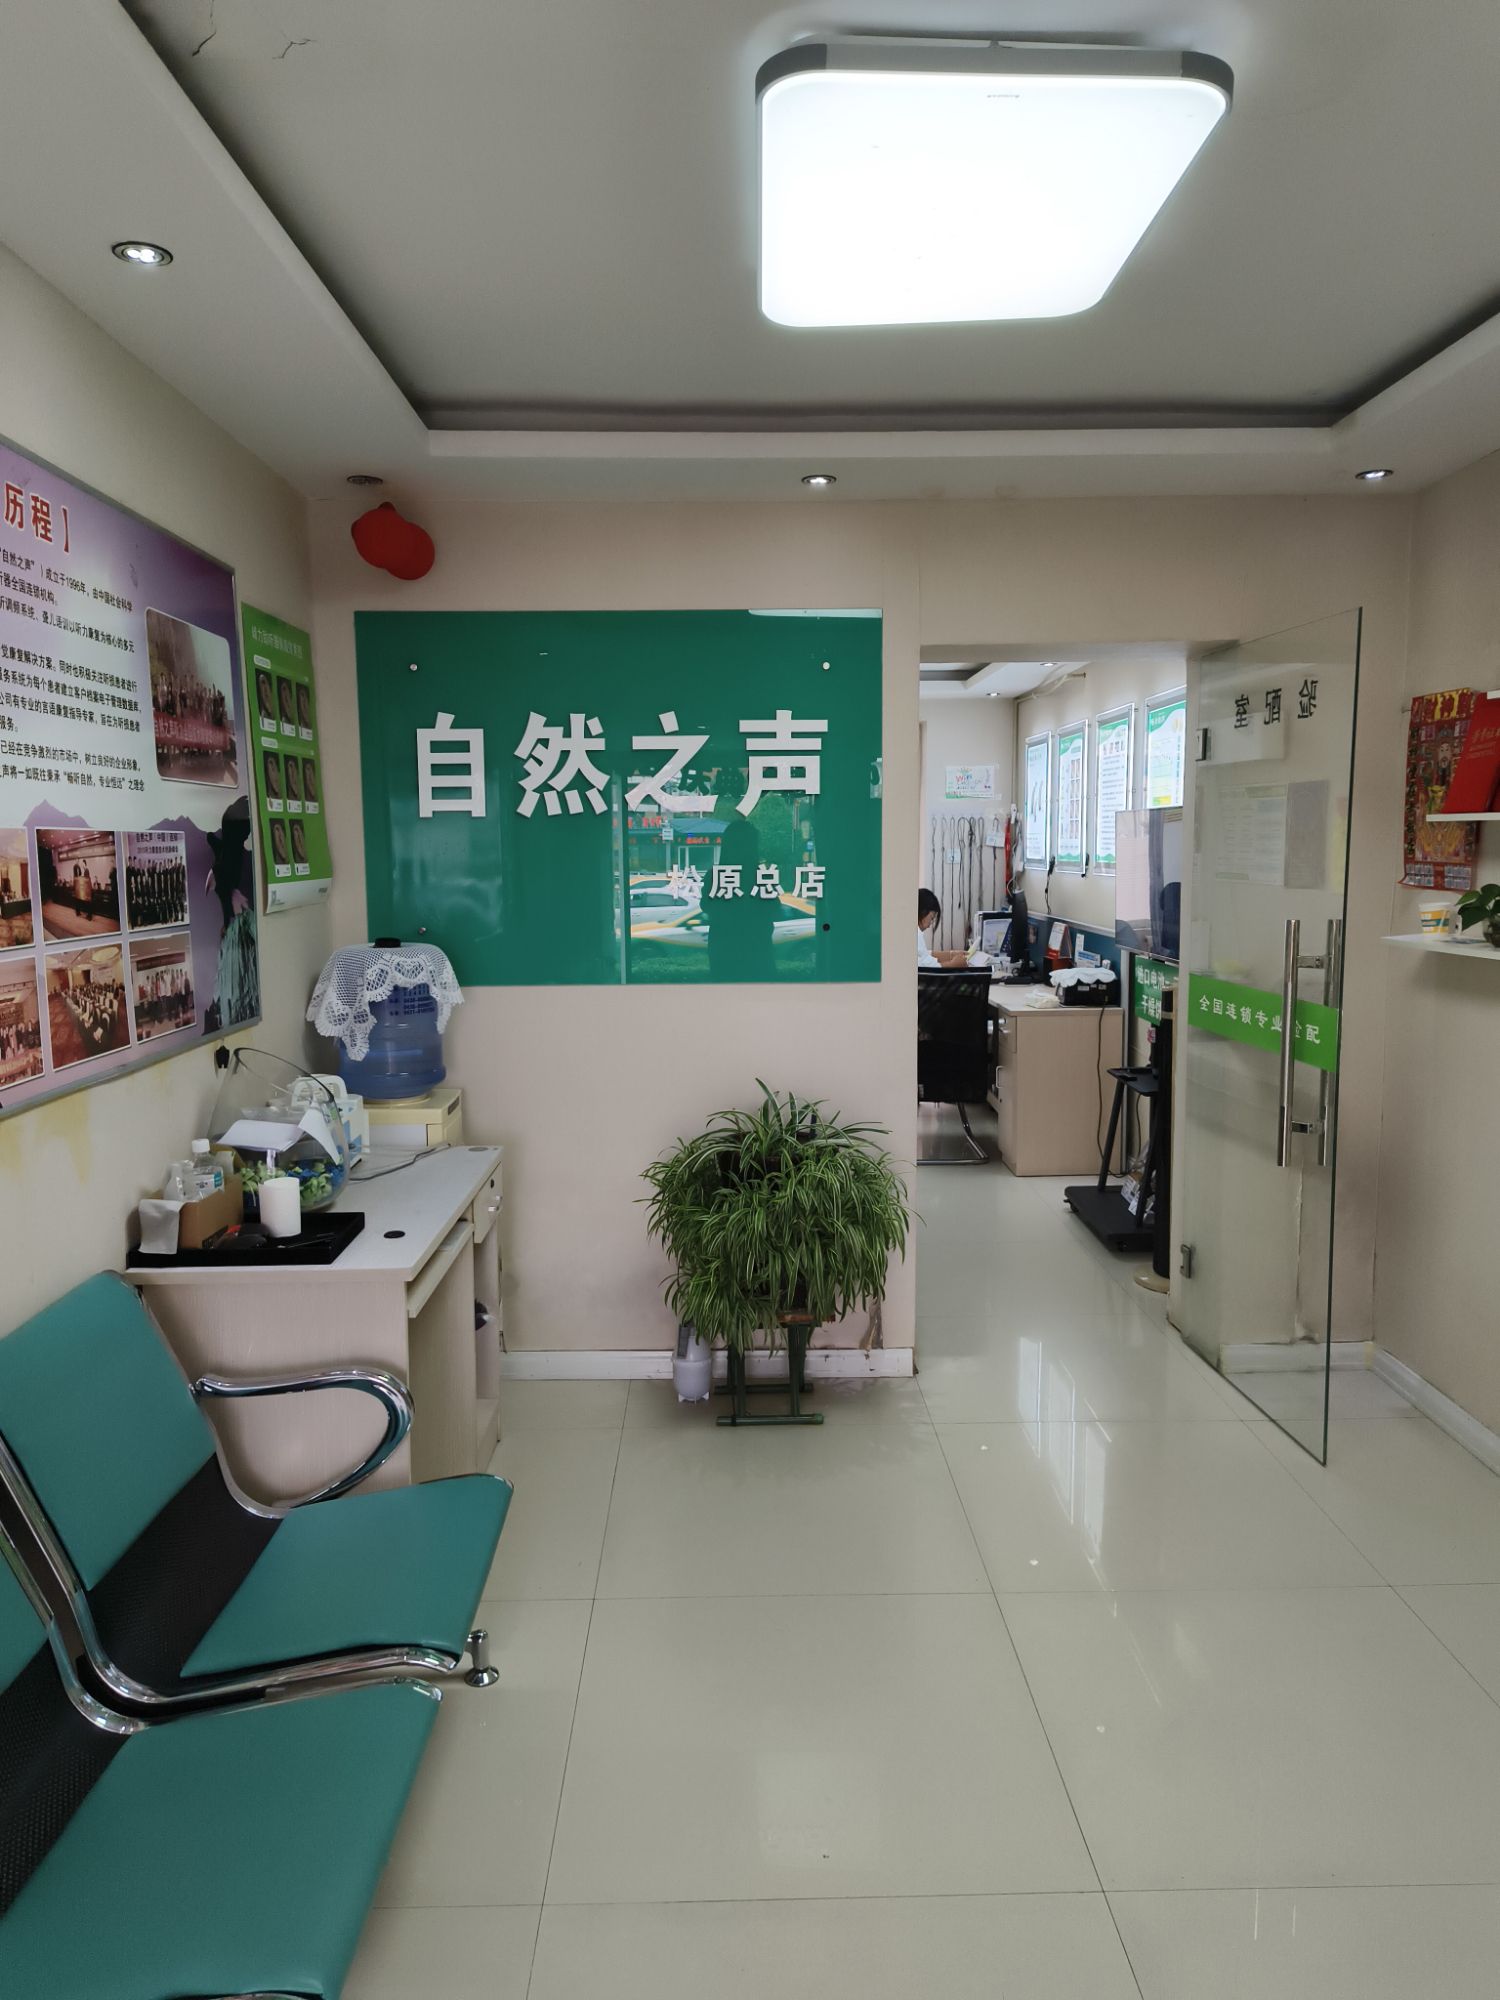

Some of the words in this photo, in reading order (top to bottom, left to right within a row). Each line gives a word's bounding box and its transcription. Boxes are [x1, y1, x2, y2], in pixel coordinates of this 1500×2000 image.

[416, 710, 829, 819] 自然之声
[668, 864, 827, 901] 松原总店
